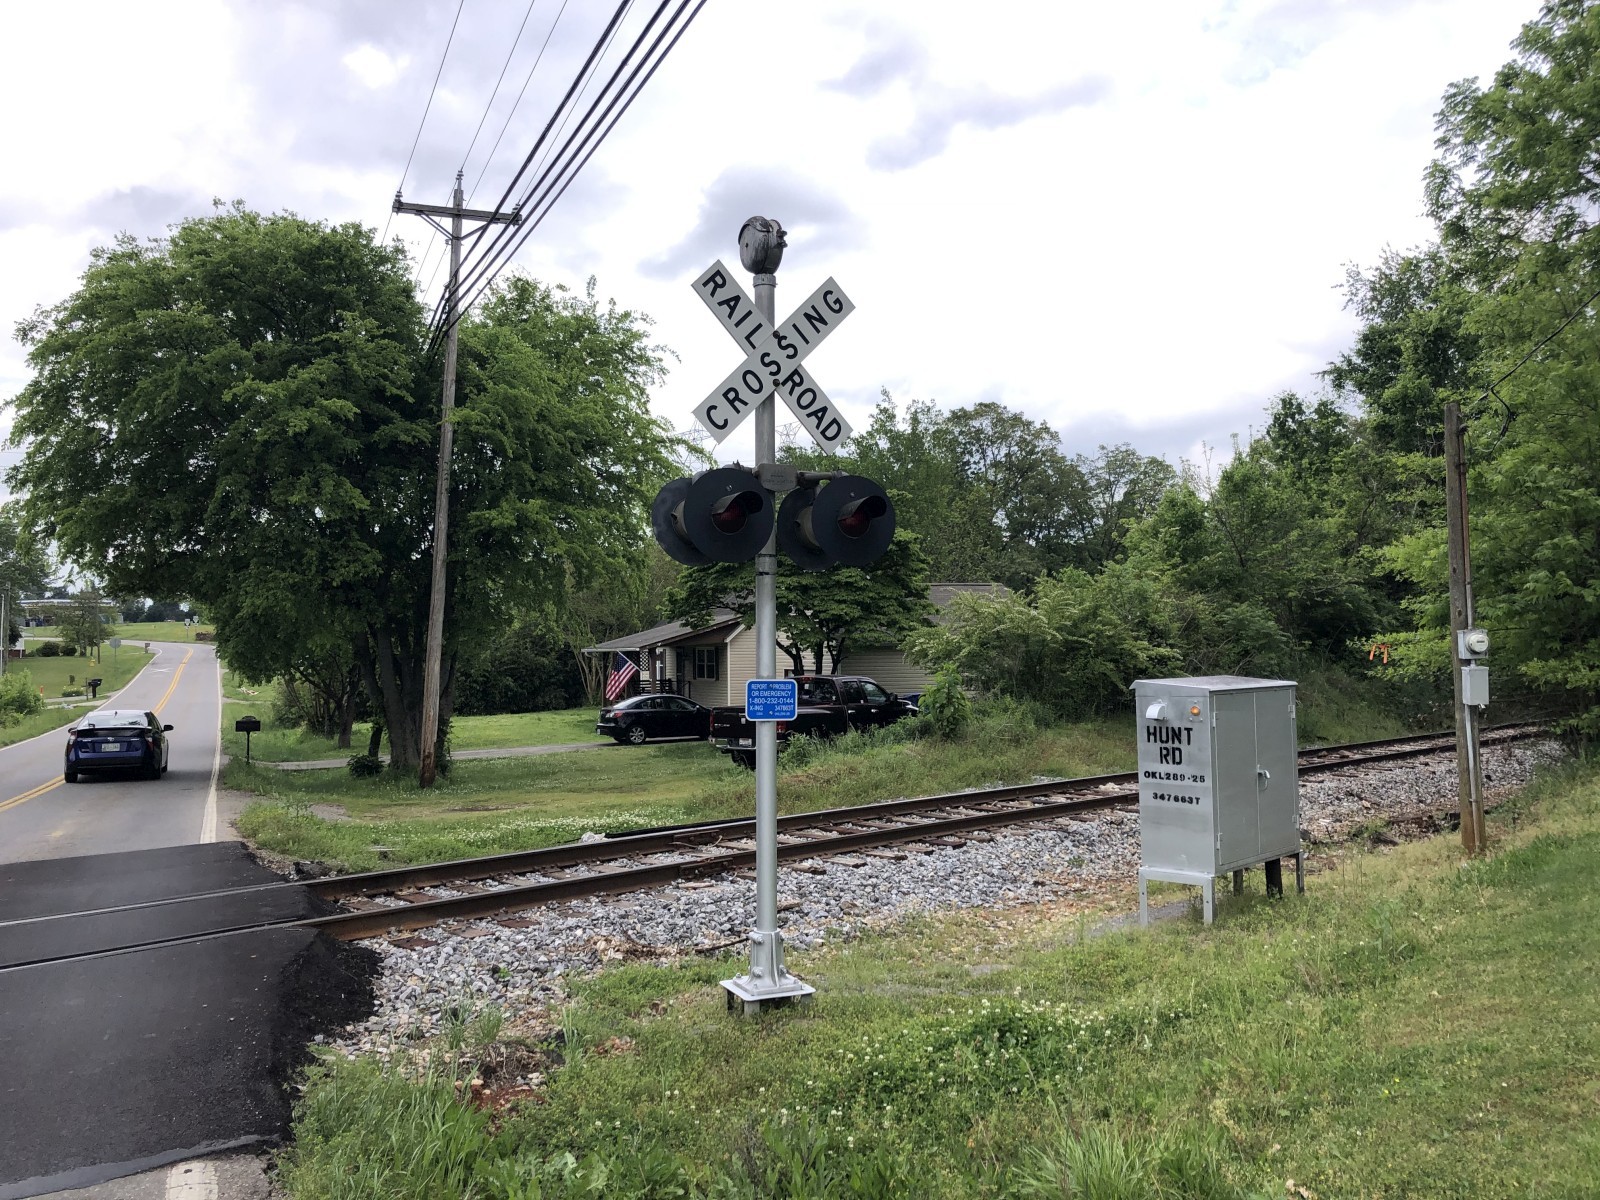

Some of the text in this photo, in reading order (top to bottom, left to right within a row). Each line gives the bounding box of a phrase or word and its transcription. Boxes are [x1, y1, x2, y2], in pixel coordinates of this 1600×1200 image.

[702, 269, 842, 442] RAIL ROAD
[706, 289, 844, 430] CROSSING
[1146, 725, 1193, 746] HUNT
[1159, 746, 1183, 765] RD
[1152, 792, 1201, 805] 347663T
